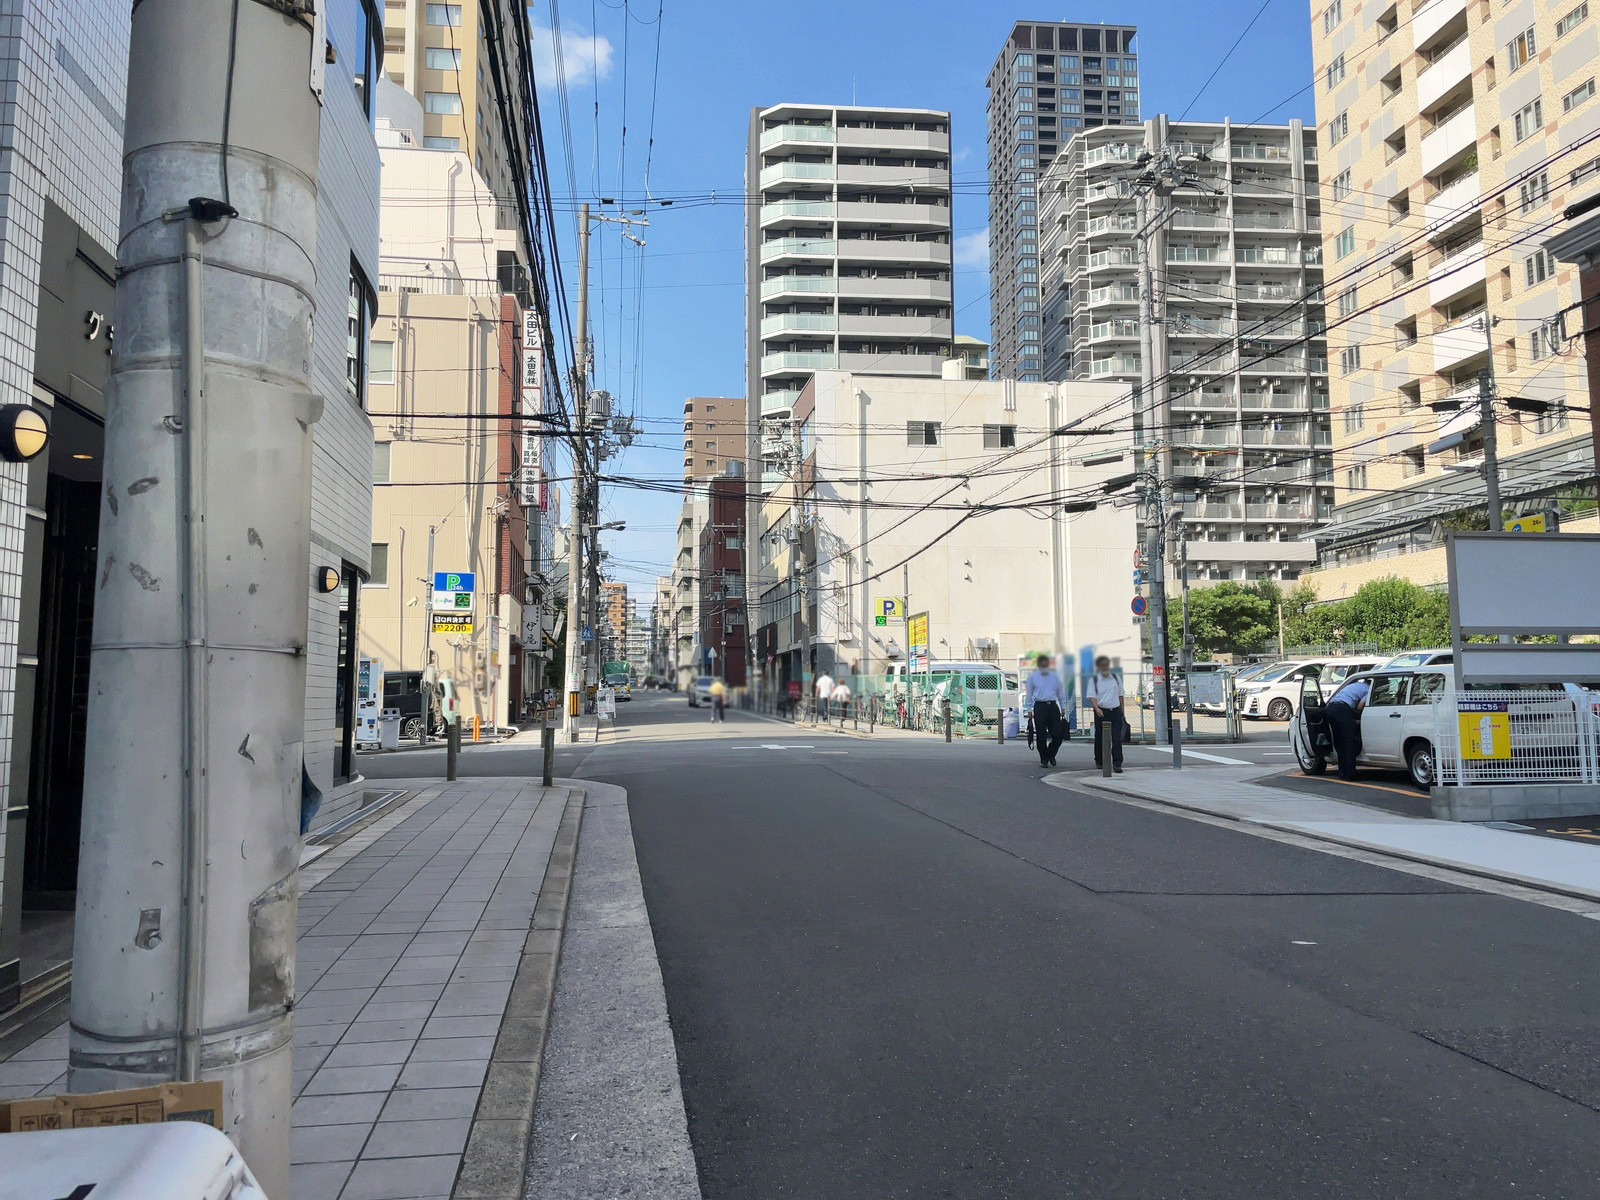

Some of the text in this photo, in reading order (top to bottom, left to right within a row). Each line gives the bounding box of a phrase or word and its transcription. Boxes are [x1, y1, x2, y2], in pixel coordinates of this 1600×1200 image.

[527, 312, 538, 346] 太田ビル
[446, 574, 461, 591] P
[883, 600, 895, 615] P
